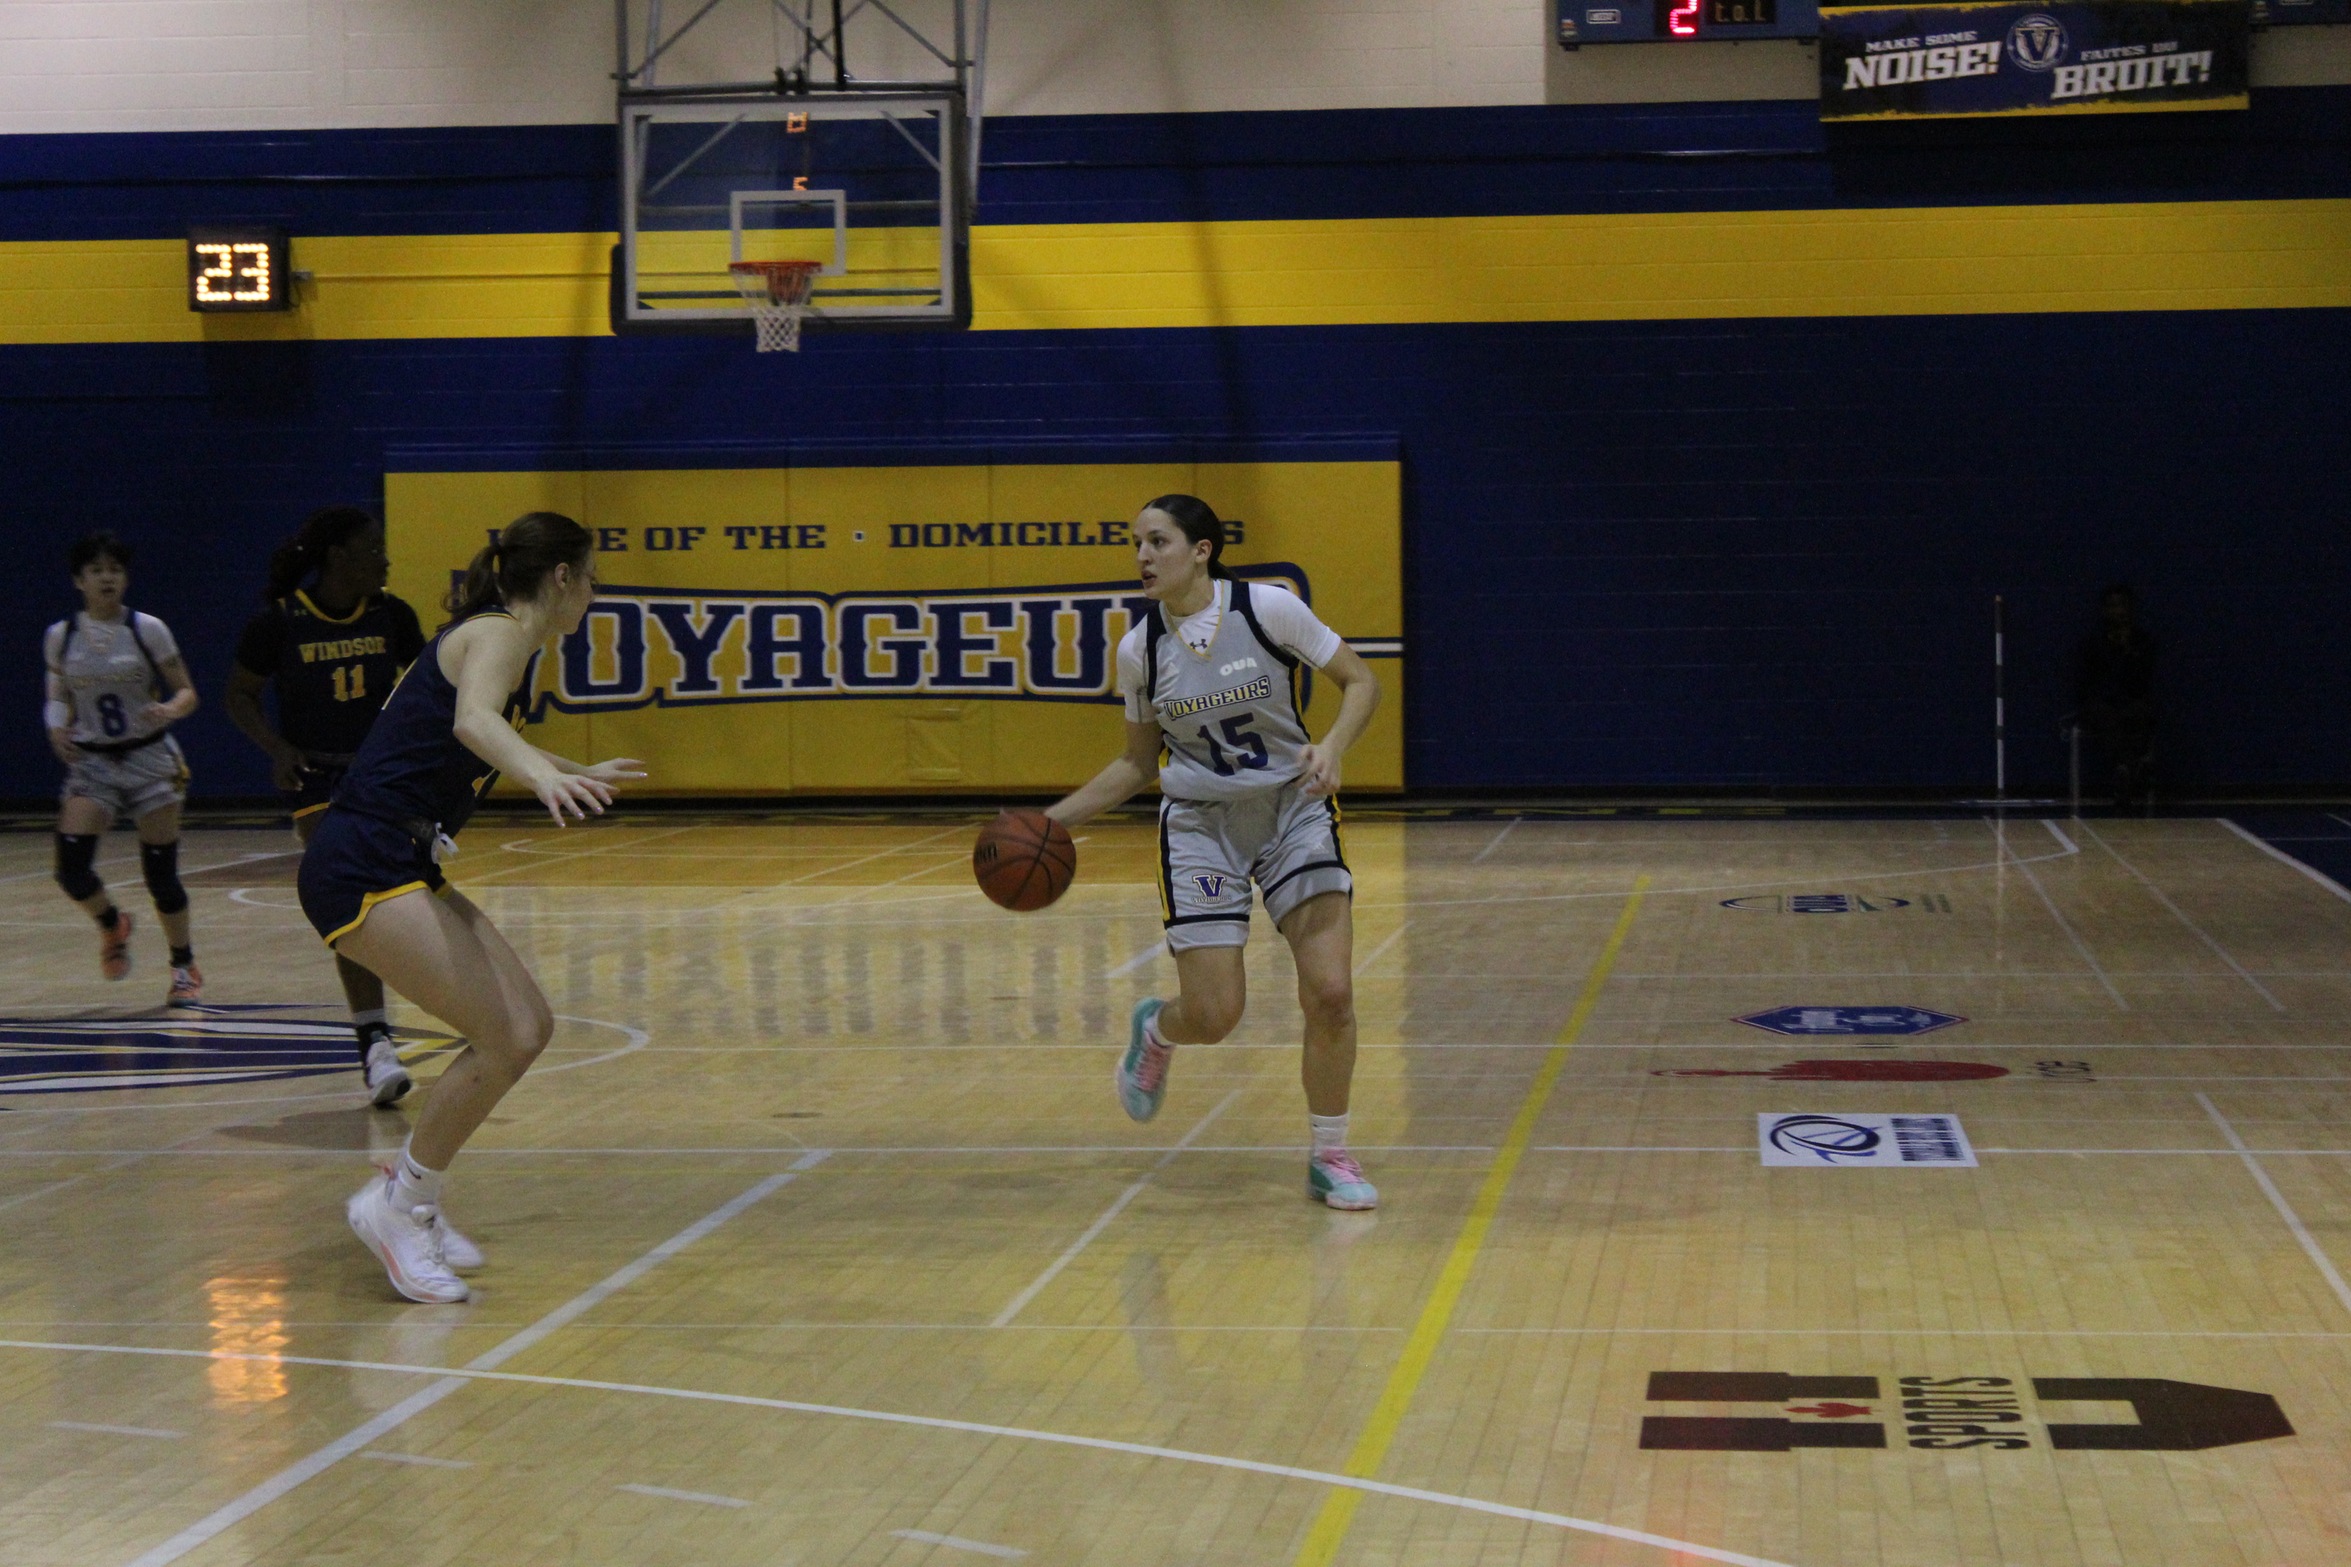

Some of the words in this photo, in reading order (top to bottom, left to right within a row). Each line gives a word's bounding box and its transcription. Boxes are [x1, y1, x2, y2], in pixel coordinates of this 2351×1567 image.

[1865, 37, 1921, 53] MAKE
[1924, 30, 1979, 46] SOME
[1842, 41, 2003, 91] NOISE!
[2051, 50, 2213, 99] BRUIT!
[196, 243, 269, 301] 23
[644, 527, 706, 551] OF
[724, 525, 826, 550] THE
[889, 521, 1129, 548] DOMICILE
[299, 636, 387, 663] WINDSOR
[1220, 657, 1258, 676] OUA
[331, 664, 367, 702] 11
[1164, 675, 1272, 721] VOYAGEURS
[98, 693, 127, 738] 8
[1196, 711, 1269, 777] 15
[1898, 1376, 2031, 1451] SPORTS
